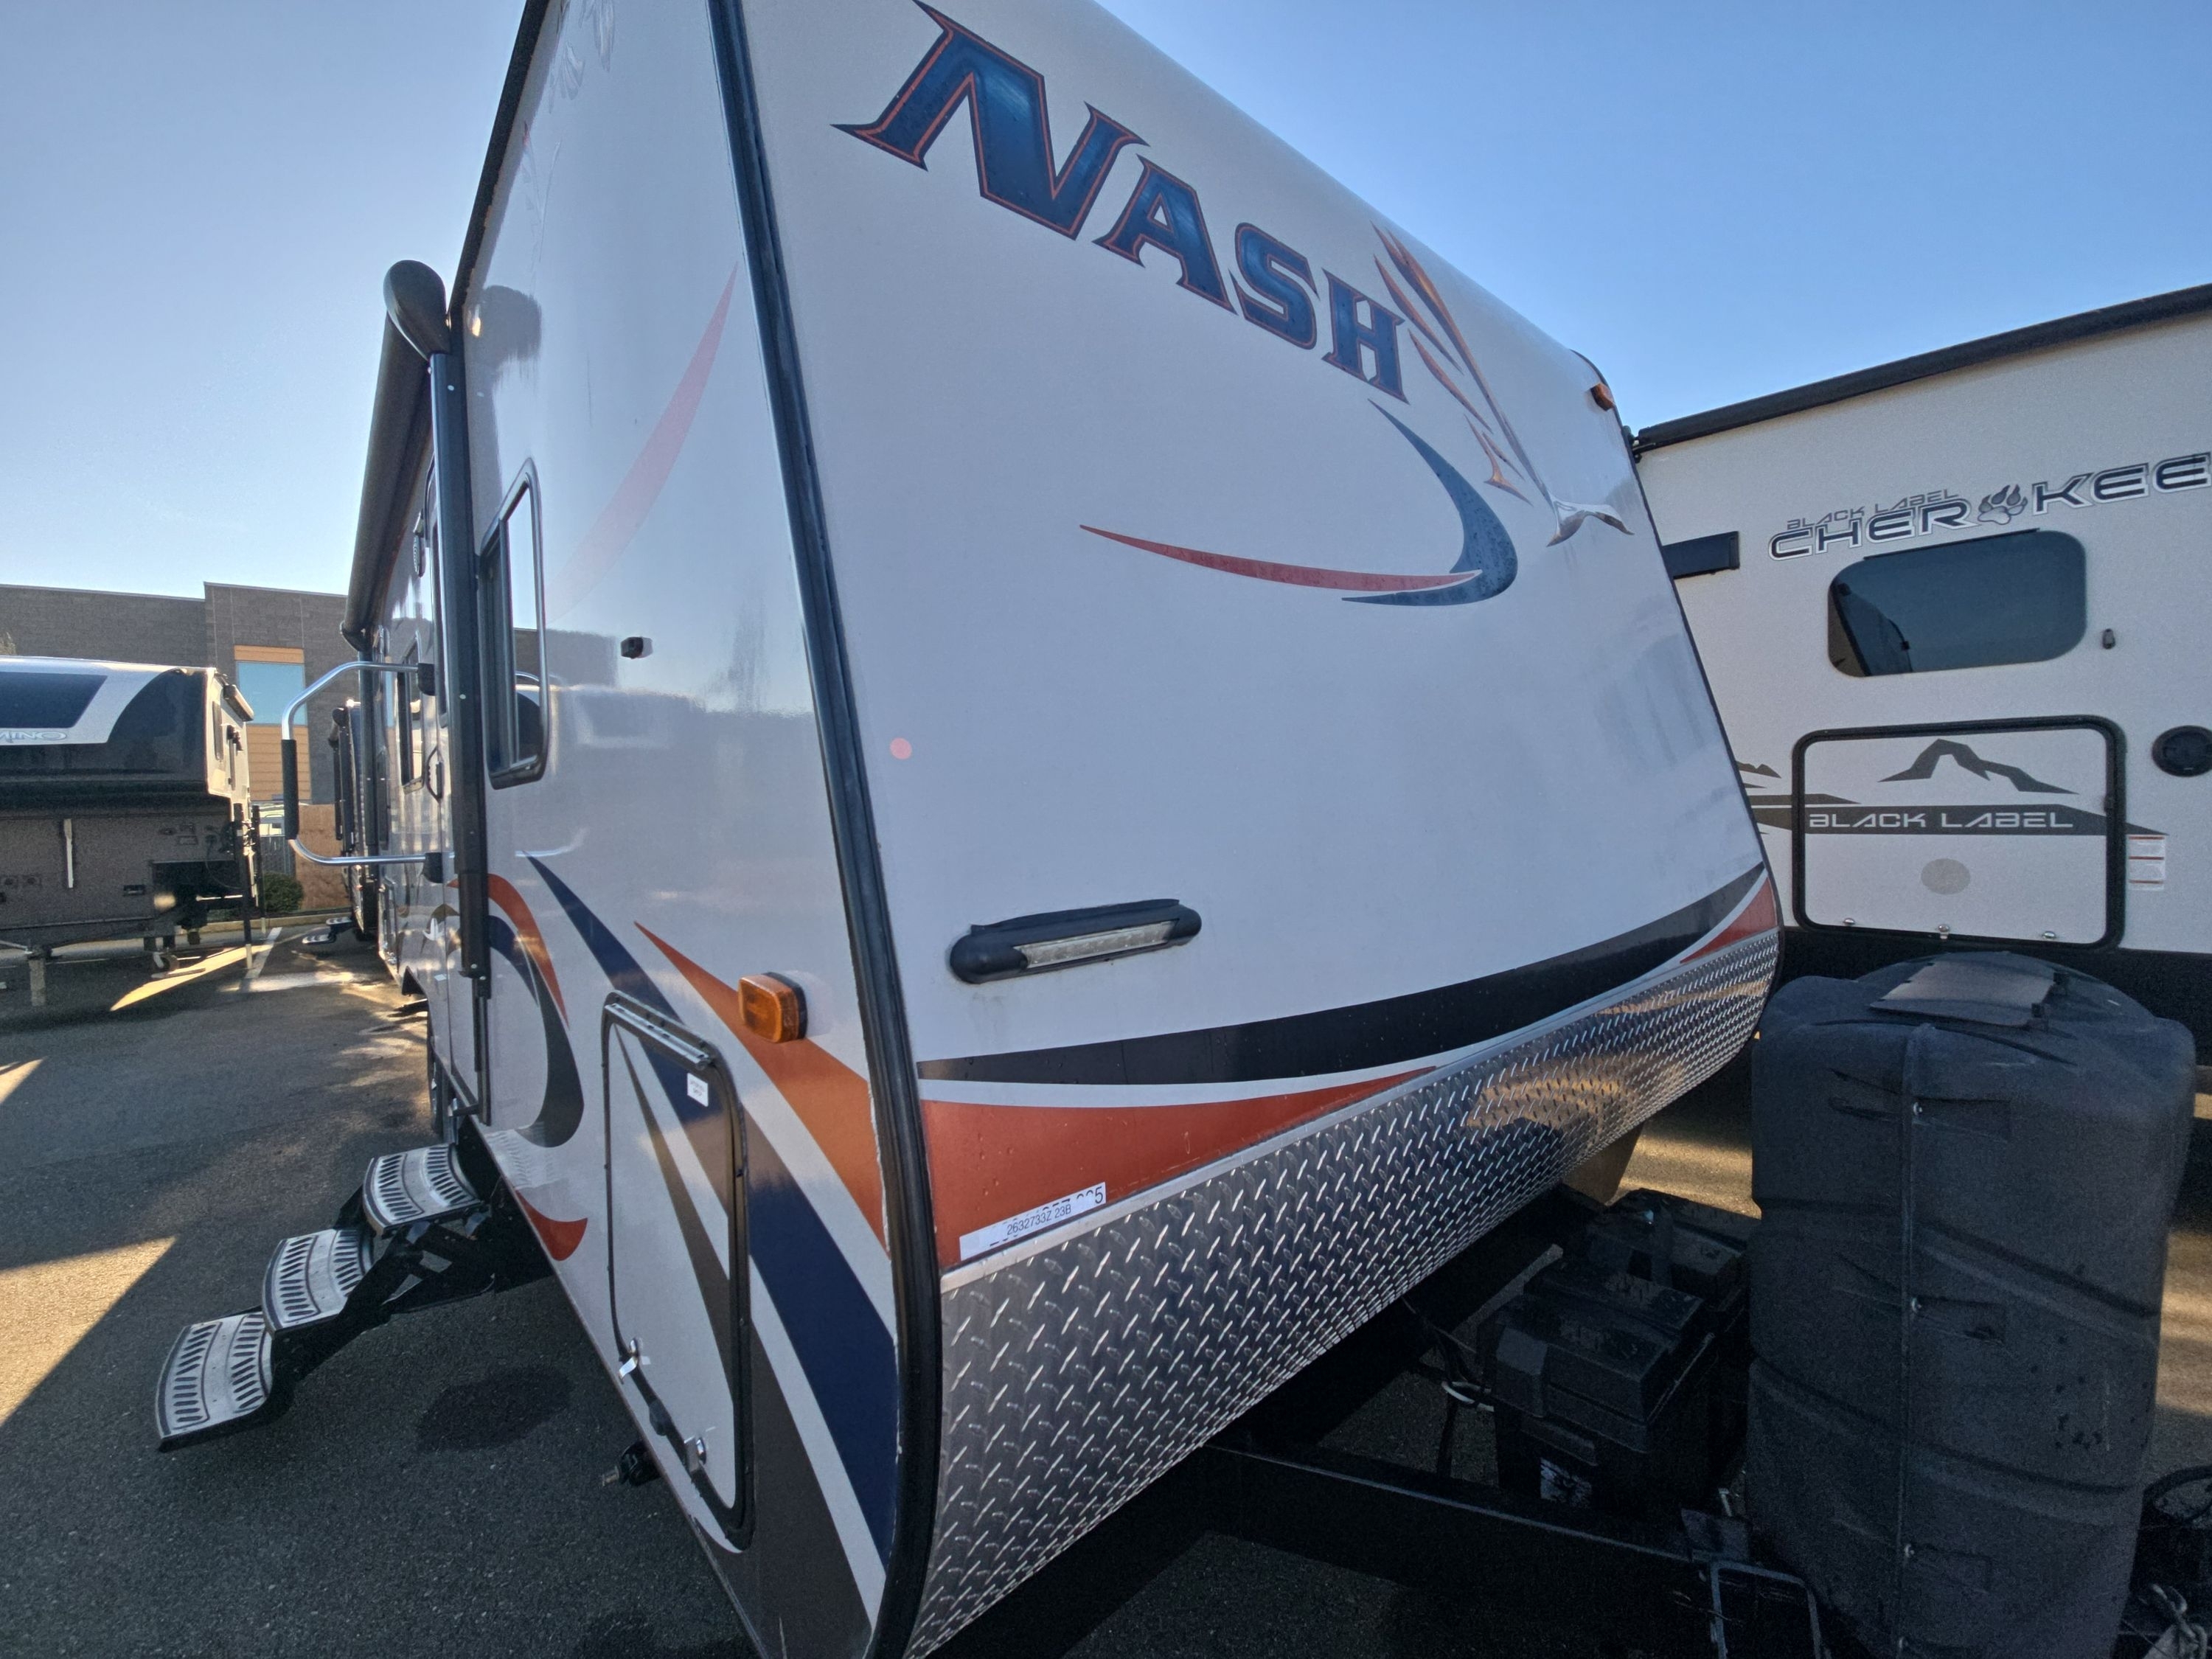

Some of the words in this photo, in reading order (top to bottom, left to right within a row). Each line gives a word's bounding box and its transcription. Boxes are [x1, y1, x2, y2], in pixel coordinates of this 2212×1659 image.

[831, 0, 1409, 403] NASH
[1787, 506, 1865, 530] BLACK
[1874, 488, 1959, 514] LABEL
[1809, 813, 1927, 828] BLACK
[1941, 811, 2074, 828] LABEL
